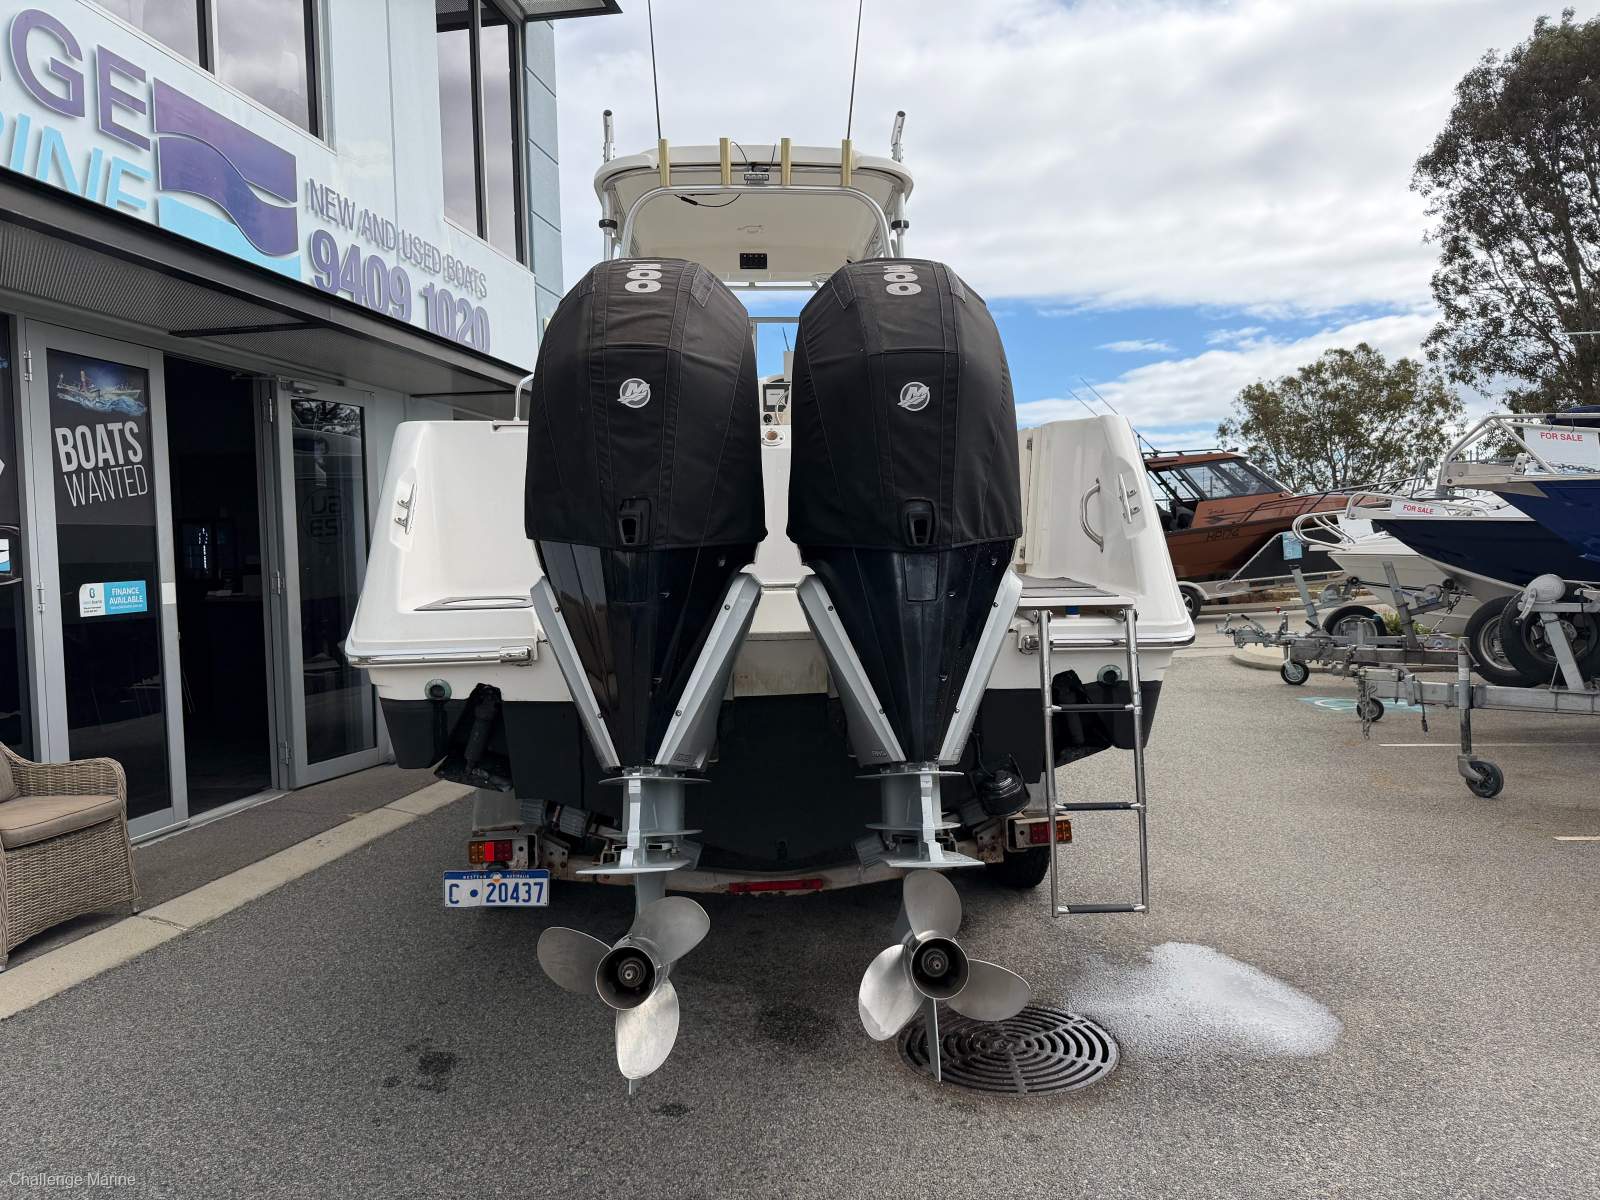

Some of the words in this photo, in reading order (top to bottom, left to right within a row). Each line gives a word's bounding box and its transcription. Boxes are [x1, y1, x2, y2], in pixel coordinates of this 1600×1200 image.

[0, 111, 153, 209] INE
[308, 178, 356, 231] NEW
[359, 208, 398, 251] AND
[401, 229, 442, 275] USED
[445, 253, 488, 299] BOATS
[311, 229, 412, 323] 9409
[421, 282, 491, 355] 1020
[55, 421, 143, 473] BOATS
[1540, 432, 1558, 440] FOR
[1560, 433, 1583, 442] SALE
[64, 465, 148, 508] WANTED
[1403, 504, 1416, 513] FOR
[1417, 506, 1434, 515] SALE
[109, 596, 144, 605] AVAILABLE
[112, 587, 140, 596] FINANCE
[449, 883, 460, 904] C
[486, 881, 544, 904] 20437
